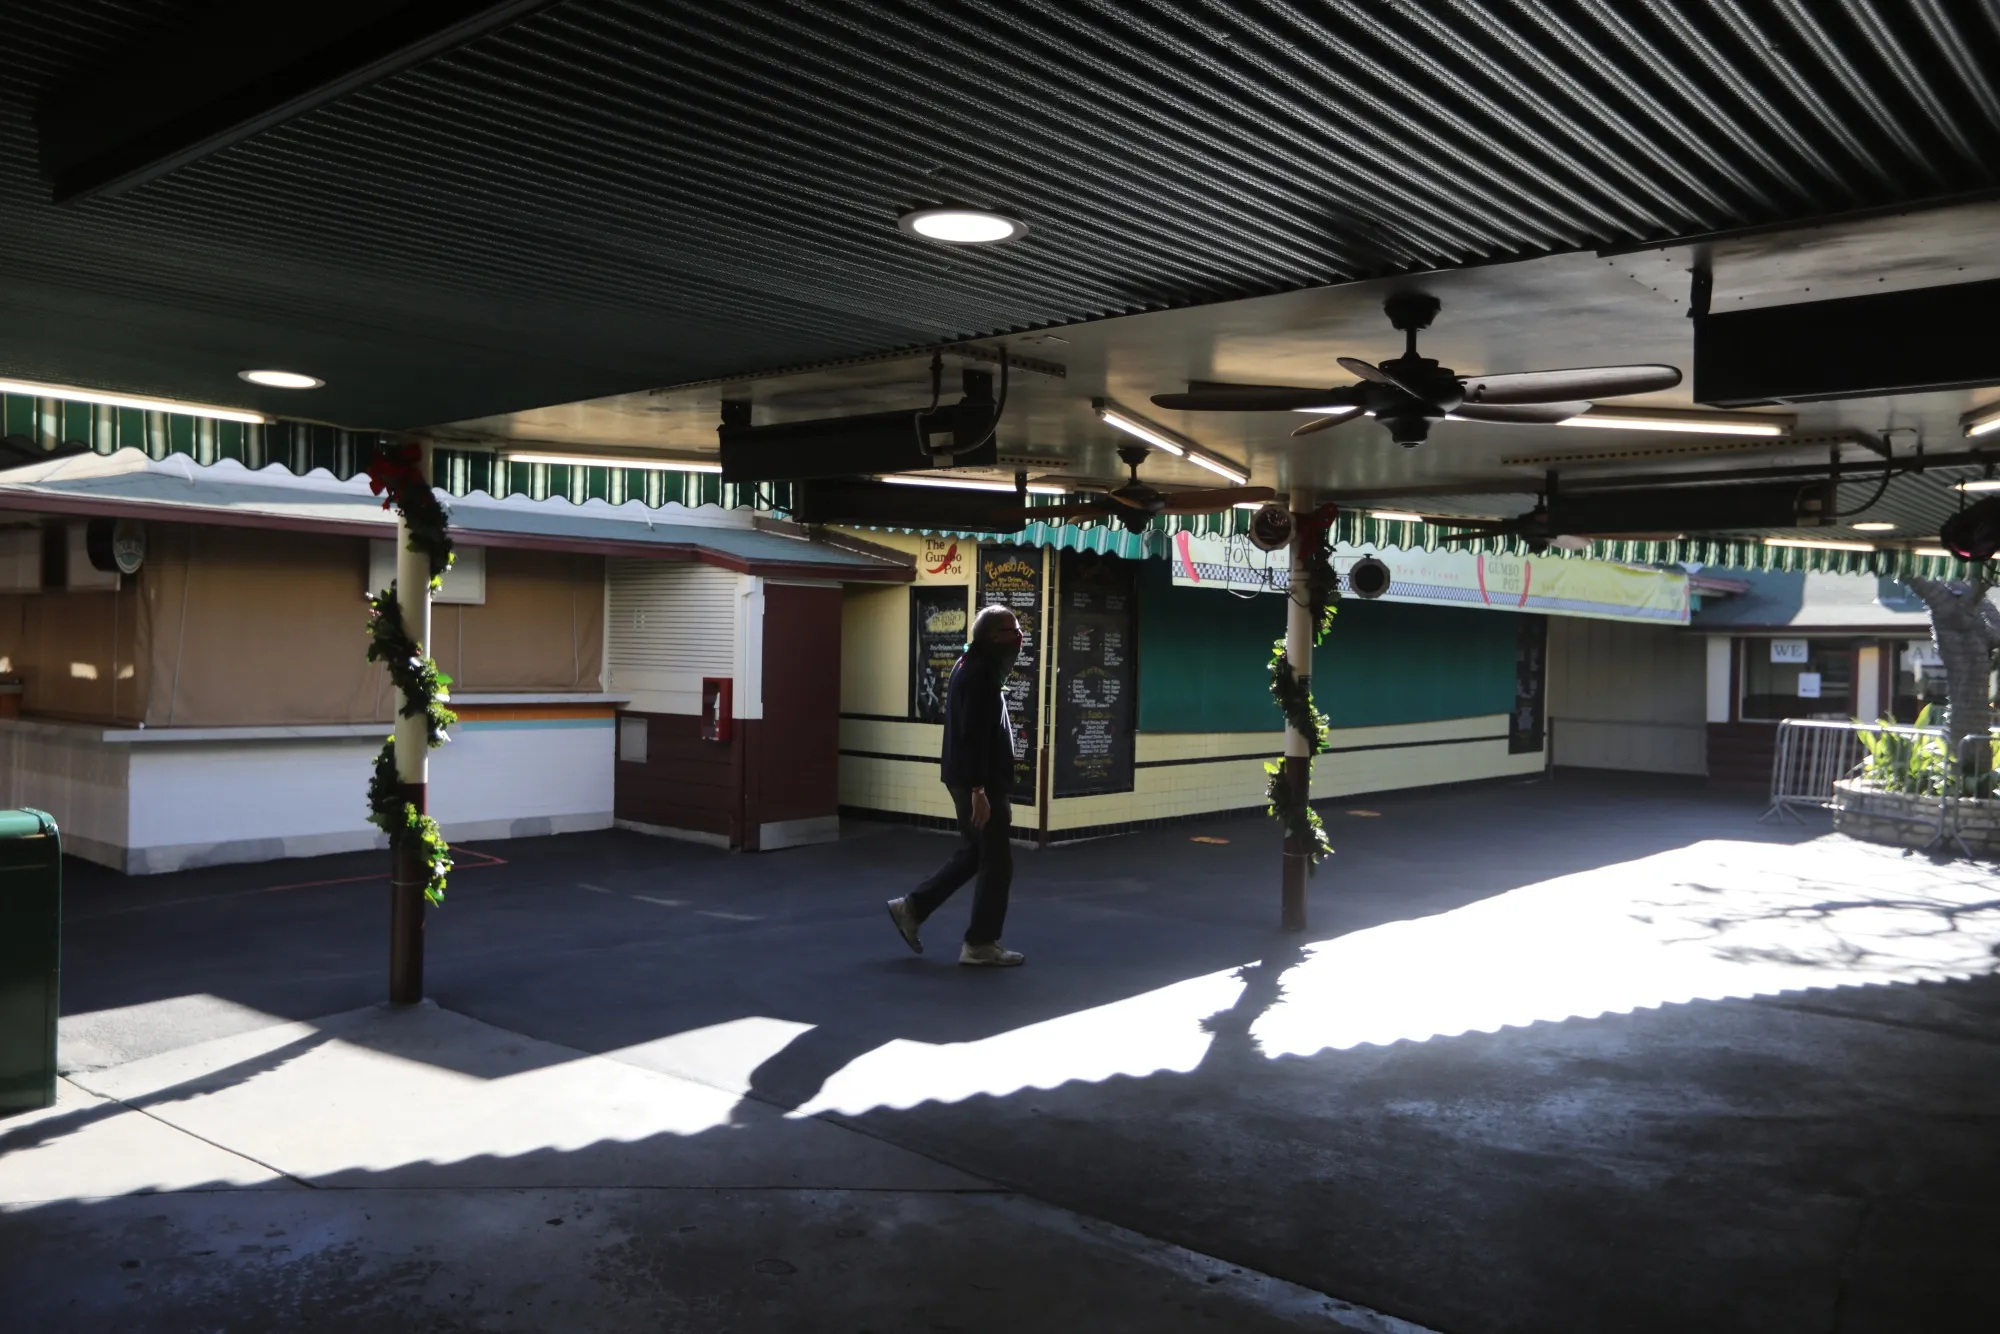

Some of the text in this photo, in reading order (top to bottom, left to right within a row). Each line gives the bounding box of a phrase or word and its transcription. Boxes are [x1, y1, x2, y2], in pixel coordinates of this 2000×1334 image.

[925, 539, 945, 550] The
[1224, 546, 1254, 564] POT
[944, 563, 962, 574] Pot
[989, 561, 1017, 579] GUMBO
[1018, 561, 1036, 578] POT
[1489, 561, 1519, 577] GUMBO
[1503, 577, 1519, 591] POT
[1773, 644, 1804, 658] WE
